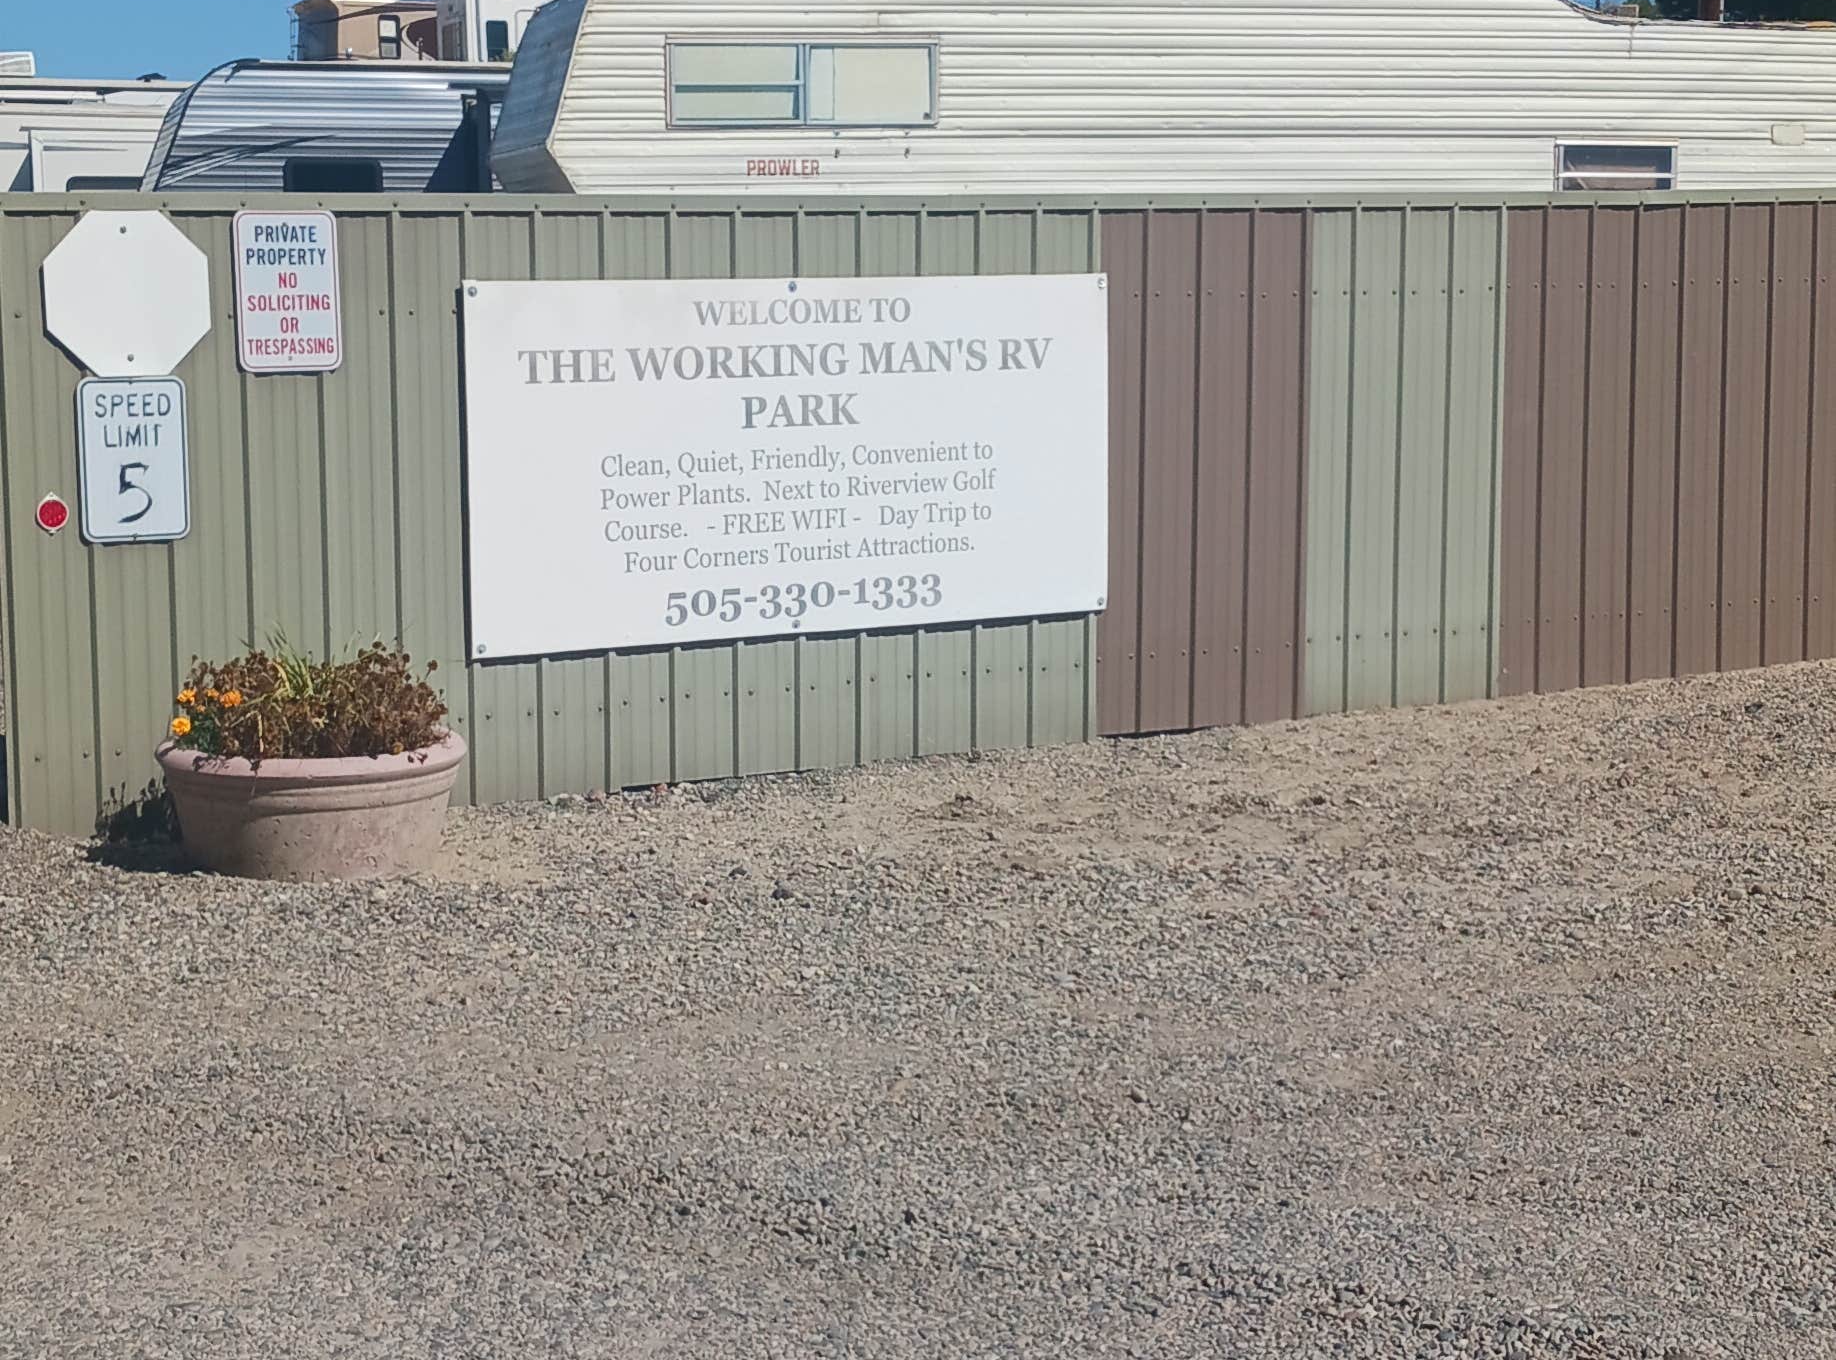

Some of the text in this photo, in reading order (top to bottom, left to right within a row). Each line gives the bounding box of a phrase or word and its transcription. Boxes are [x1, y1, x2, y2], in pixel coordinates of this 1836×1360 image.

[747, 159, 821, 177] PROWLER
[254, 226, 316, 243] PRIVATE
[246, 248, 326, 266] PROPERTY
[278, 273, 297, 289] NO
[248, 295, 330, 312] SOLICITING
[693, 298, 911, 326] WELCOME TO
[280, 318, 299, 333] OR
[248, 338, 335, 355] TRESPASSING
[518, 337, 1054, 385] THE WORKING MAN'S RV
[94, 393, 171, 418] SPEED
[741, 393, 859, 429] PARK
[103, 424, 162, 448] LIMIT
[600, 441, 994, 478] Clean, Quiet, Friendly, Convenient to
[118, 462, 152, 523] 5
[601, 469, 996, 510] Power Plants. Next to Riverview Golf
[604, 519, 688, 542] Course.
[722, 513, 786, 535] FREE
[791, 508, 848, 531] WIFI
[879, 505, 919, 529] Day
[924, 501, 967, 528] Trip
[971, 502, 992, 521] to
[624, 532, 975, 574] Four Corners Tourist Attractions.
[665, 573, 943, 626] 505-330-1333
